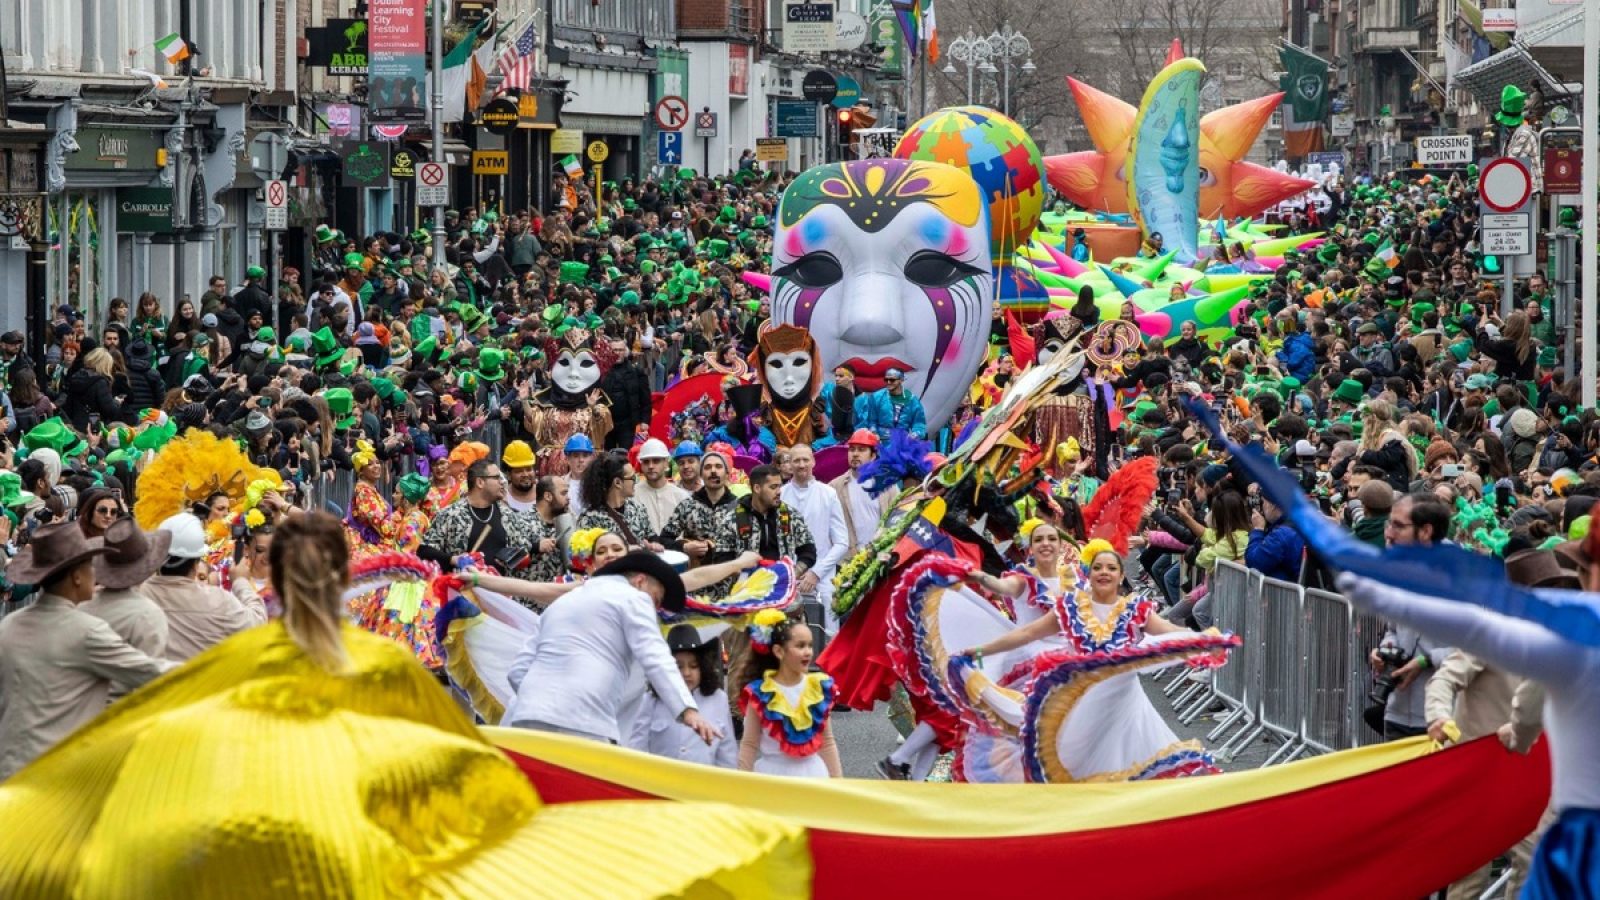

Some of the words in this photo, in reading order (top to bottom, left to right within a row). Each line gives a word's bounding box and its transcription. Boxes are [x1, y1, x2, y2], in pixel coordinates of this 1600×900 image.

[374, 7, 414, 17] Learning
[789, 7, 829, 18] COMPANY
[374, 16, 391, 26] City
[374, 25, 409, 33] Festival
[331, 53, 368, 66] ABR
[664, 133, 676, 149] P
[1420, 137, 1468, 149] CROSSING
[1426, 151, 1456, 161] POINT
[1459, 150, 1467, 160] N
[477, 157, 505, 168] ATM
[122, 201, 169, 212] CARROLLS
